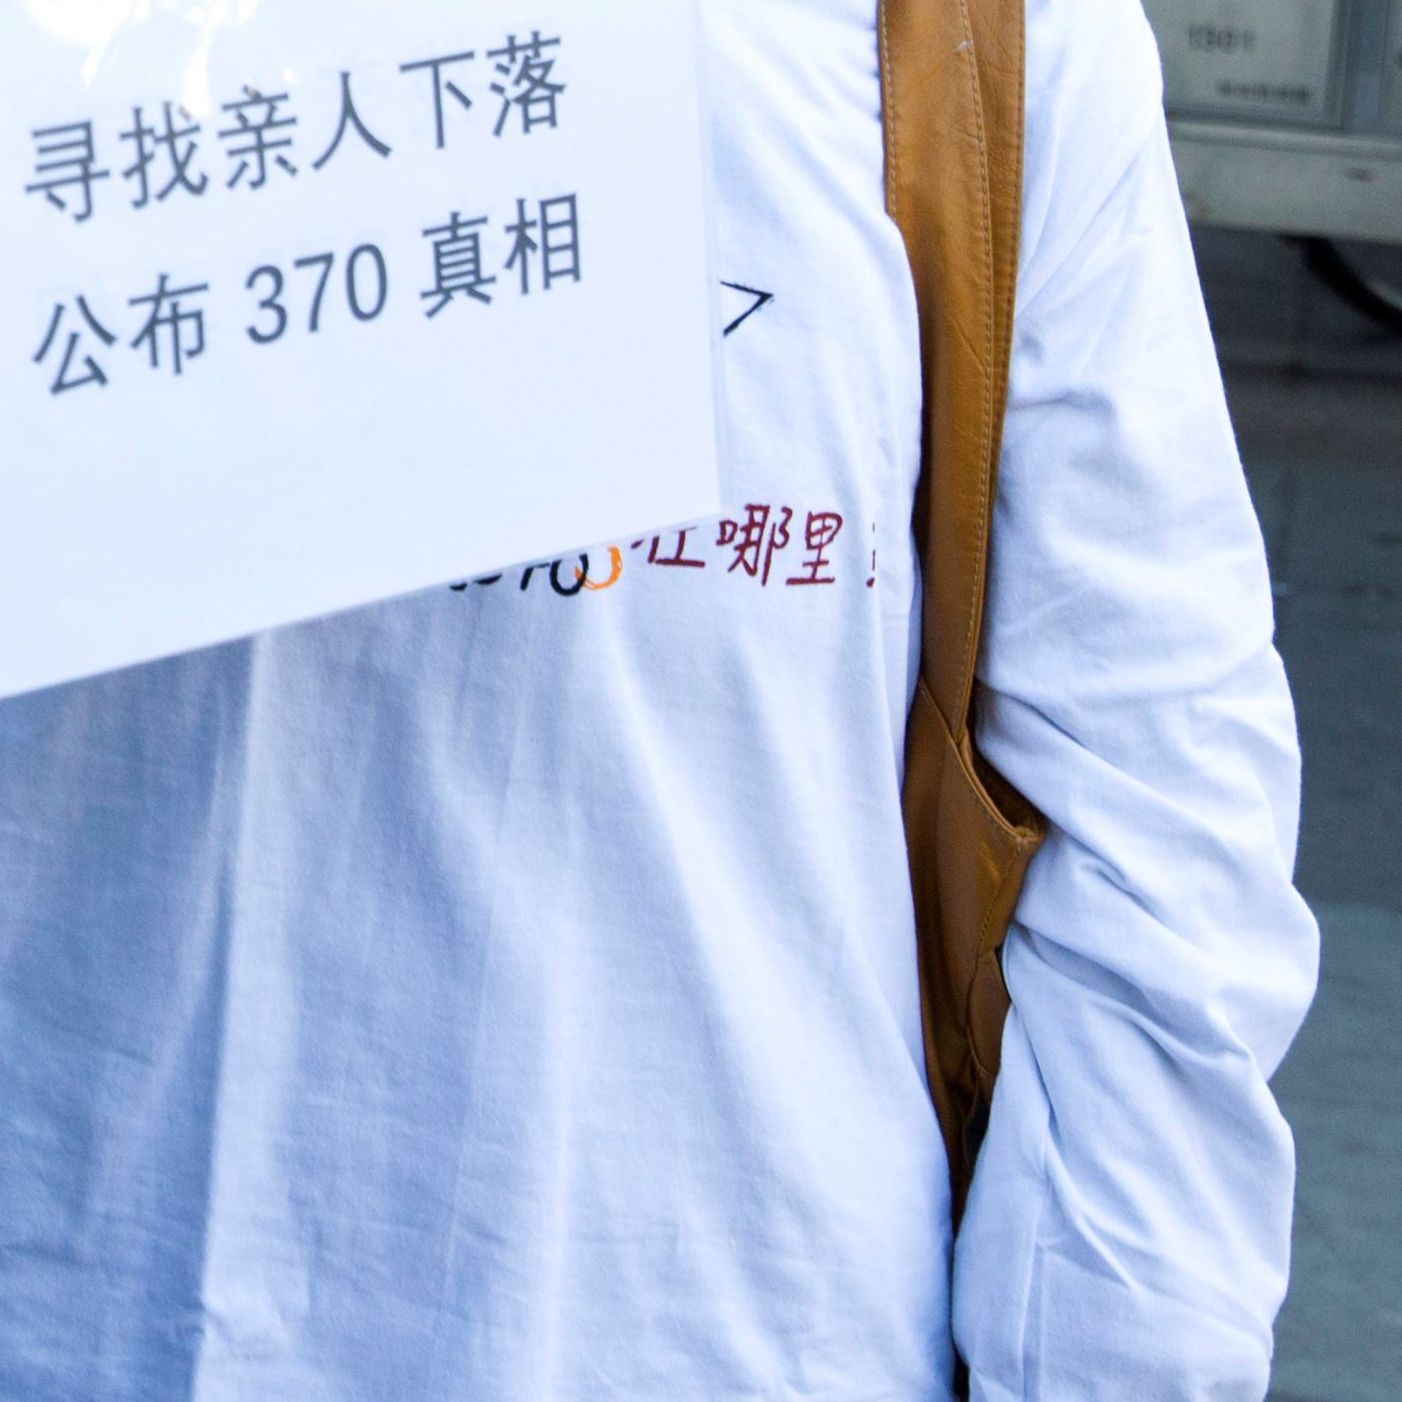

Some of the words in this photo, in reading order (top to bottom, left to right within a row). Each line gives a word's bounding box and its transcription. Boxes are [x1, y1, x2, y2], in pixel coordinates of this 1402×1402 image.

[26, 31, 579, 224] 寻找亲人下落
[33, 274, 209, 395] 公布
[246, 243, 388, 345] 370
[420, 193, 581, 319] 真相
